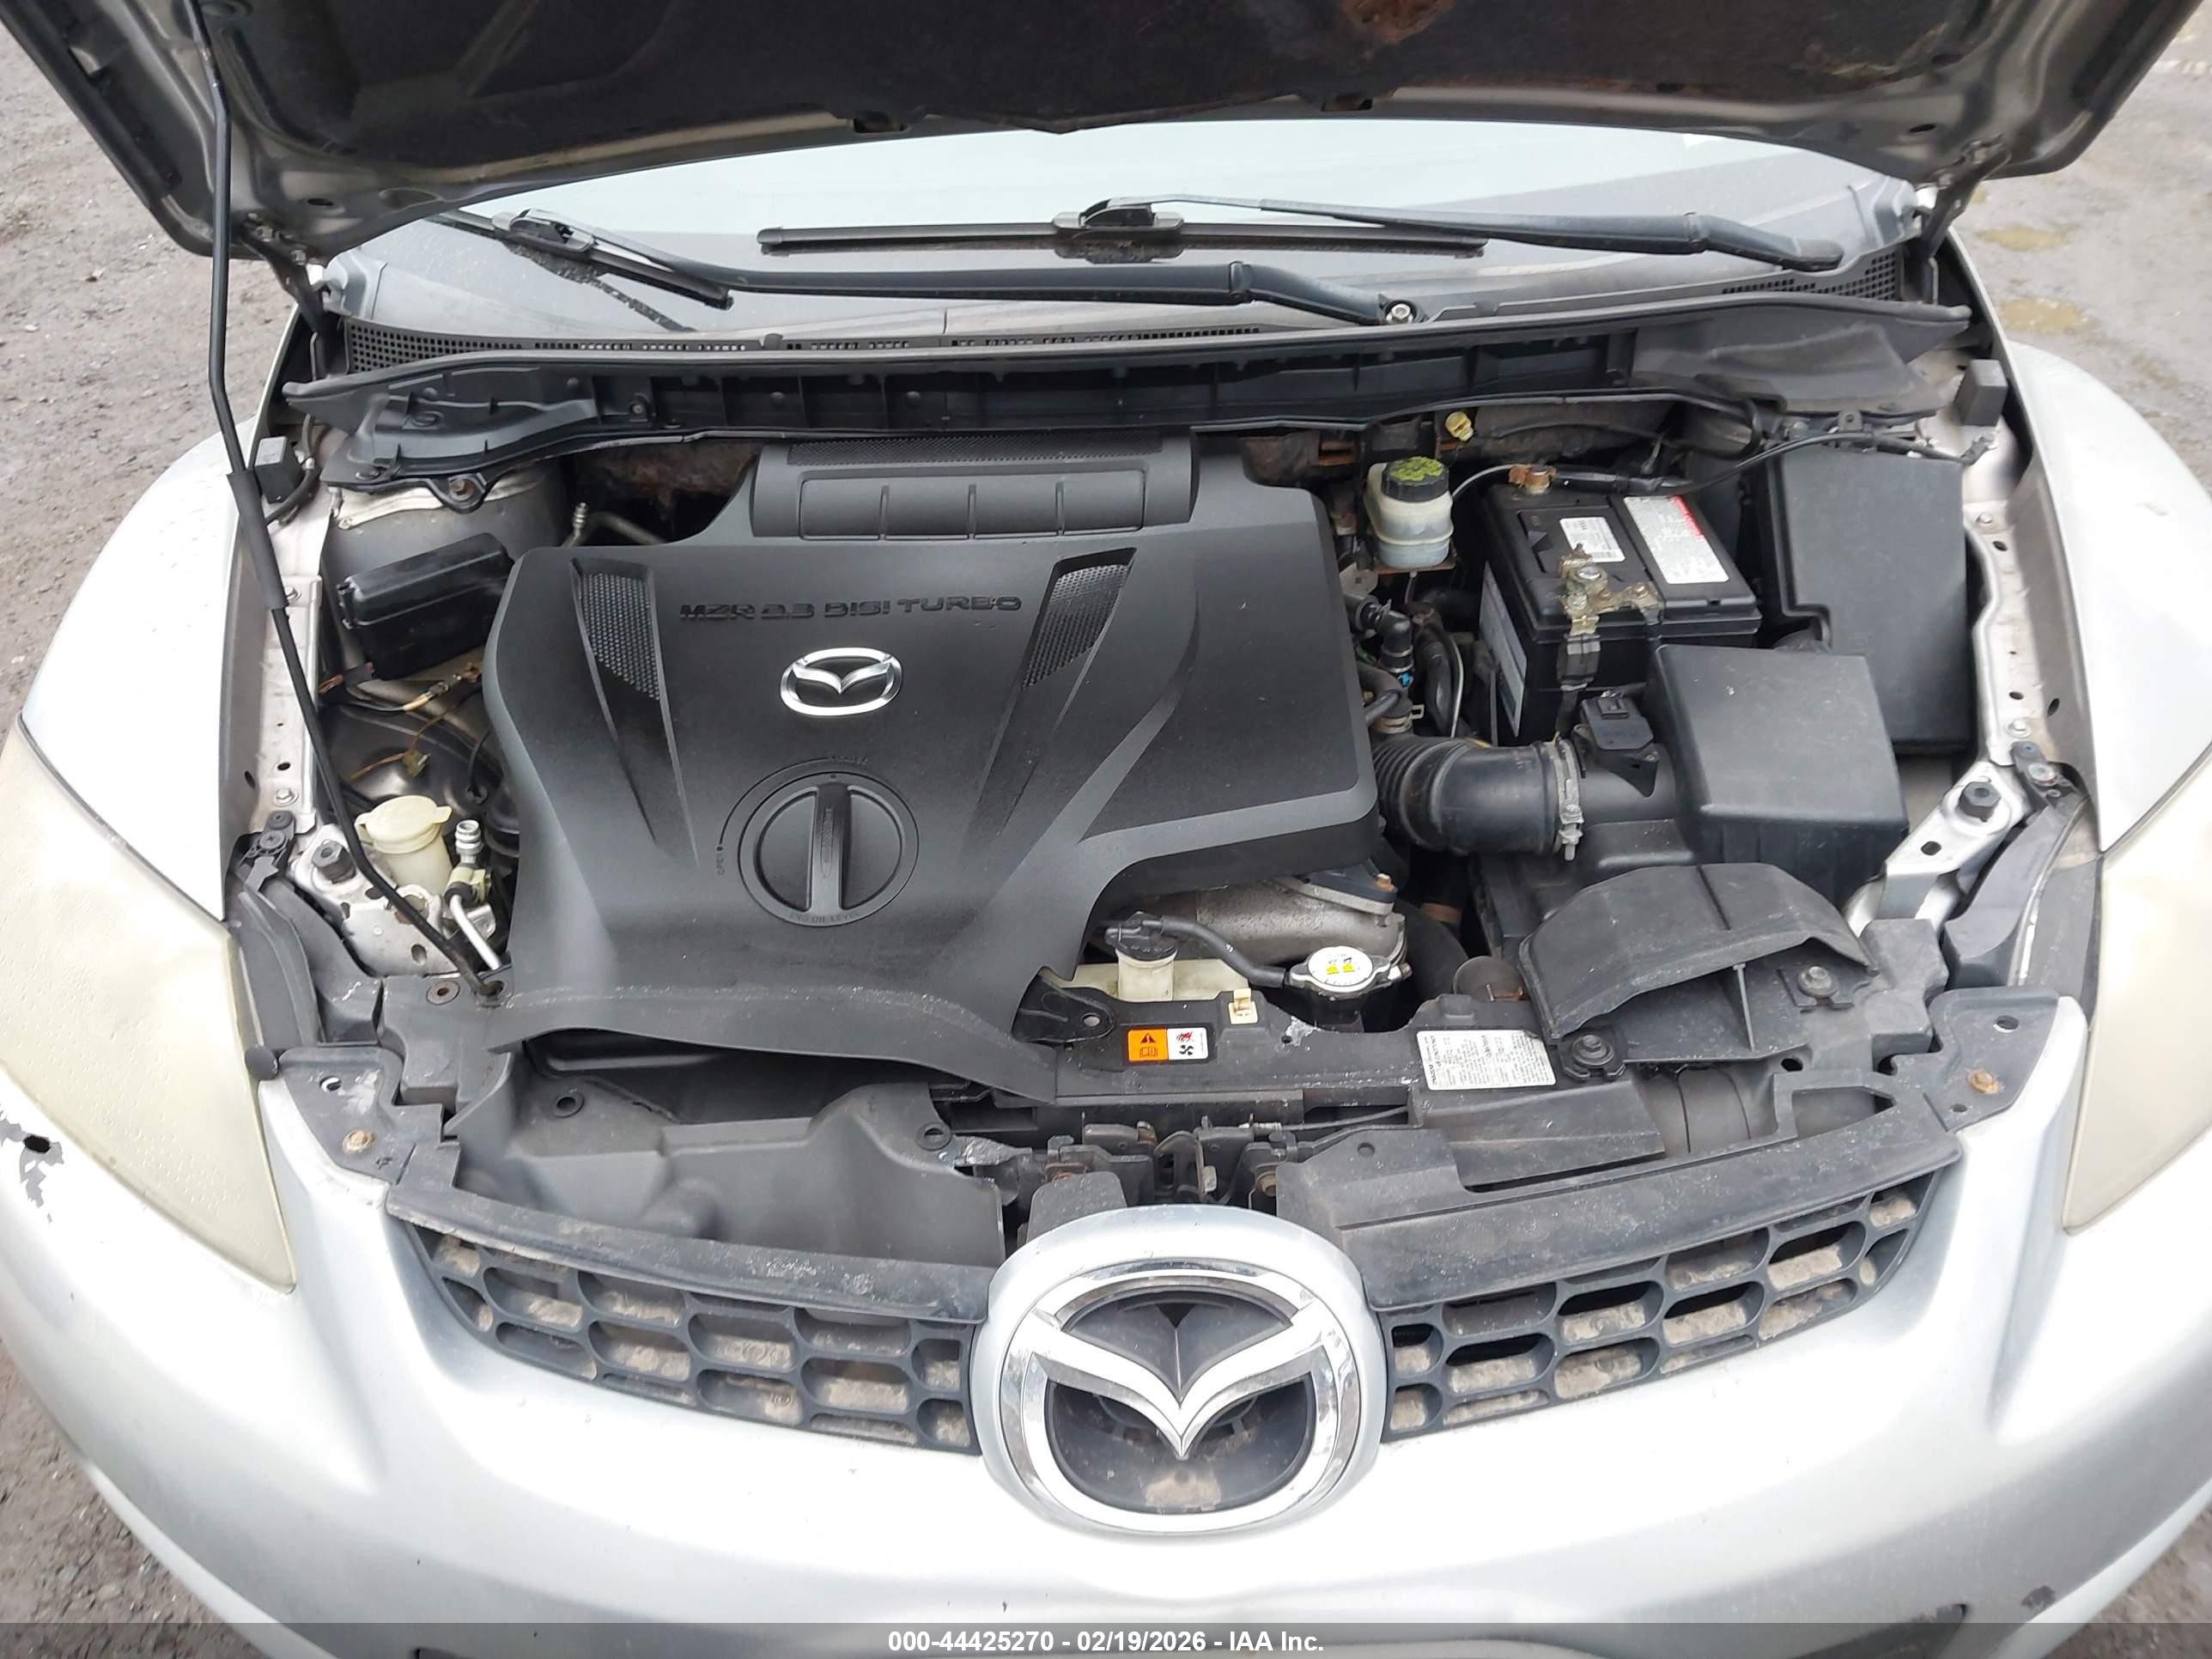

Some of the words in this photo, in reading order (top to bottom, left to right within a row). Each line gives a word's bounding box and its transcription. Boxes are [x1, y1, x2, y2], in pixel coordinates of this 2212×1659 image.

[679, 604, 756, 620] MZR
[760, 603, 815, 619] 2.3
[823, 599, 891, 618] DISI
[897, 595, 1023, 615] TURBO
